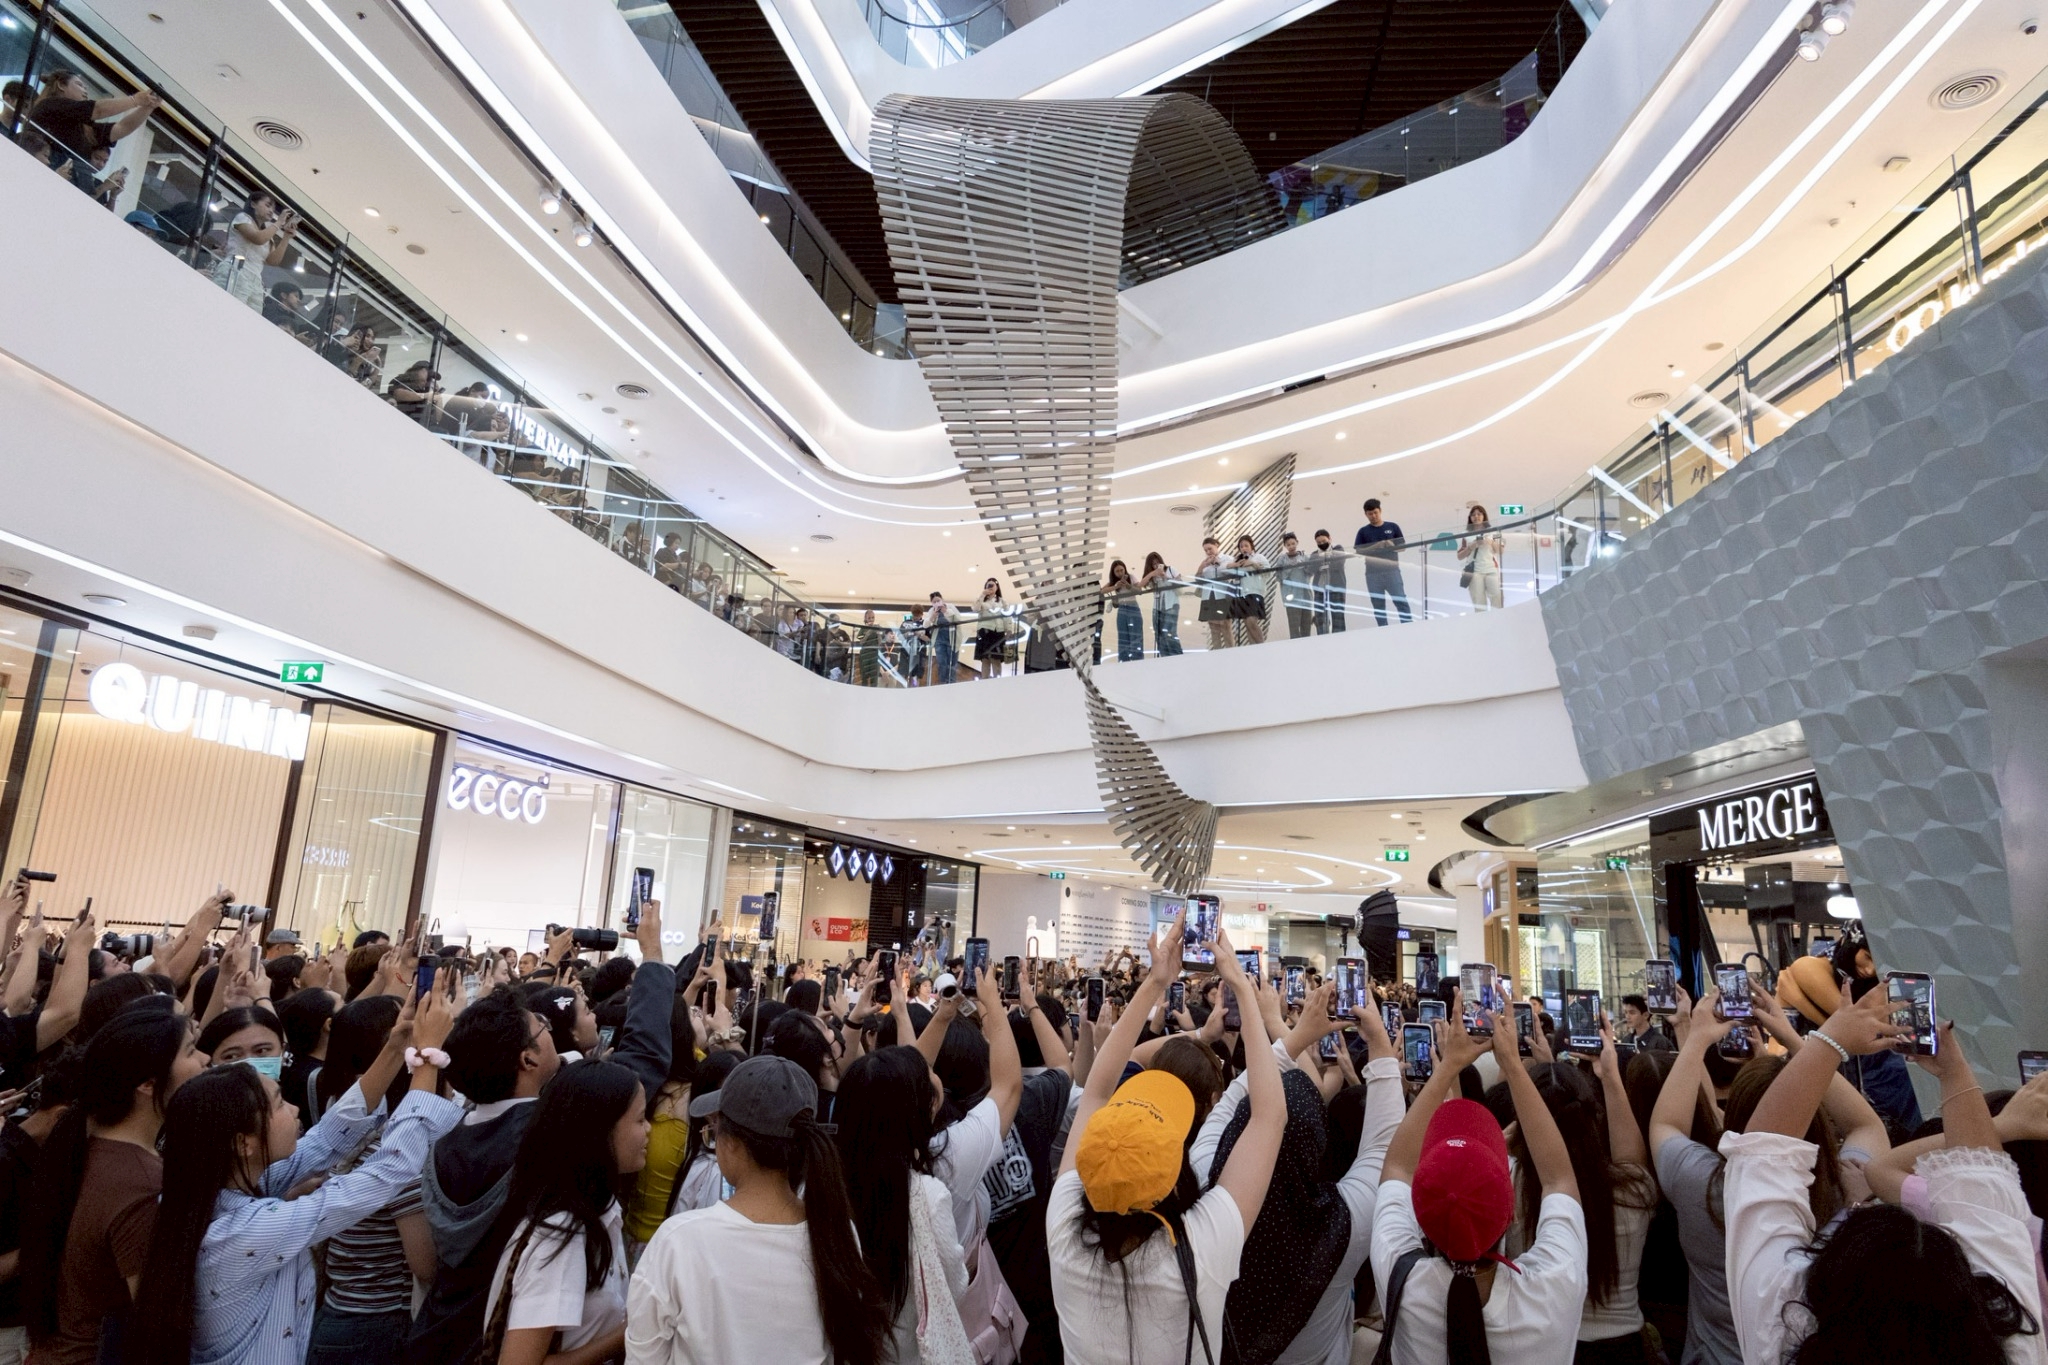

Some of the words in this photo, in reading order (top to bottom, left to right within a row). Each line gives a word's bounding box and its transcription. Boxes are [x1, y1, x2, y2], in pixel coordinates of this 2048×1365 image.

[88, 662, 311, 760] QUINN
[447, 767, 547, 825] ecco
[1697, 782, 1817, 851] MERGE
[831, 850, 891, 879] IKON
